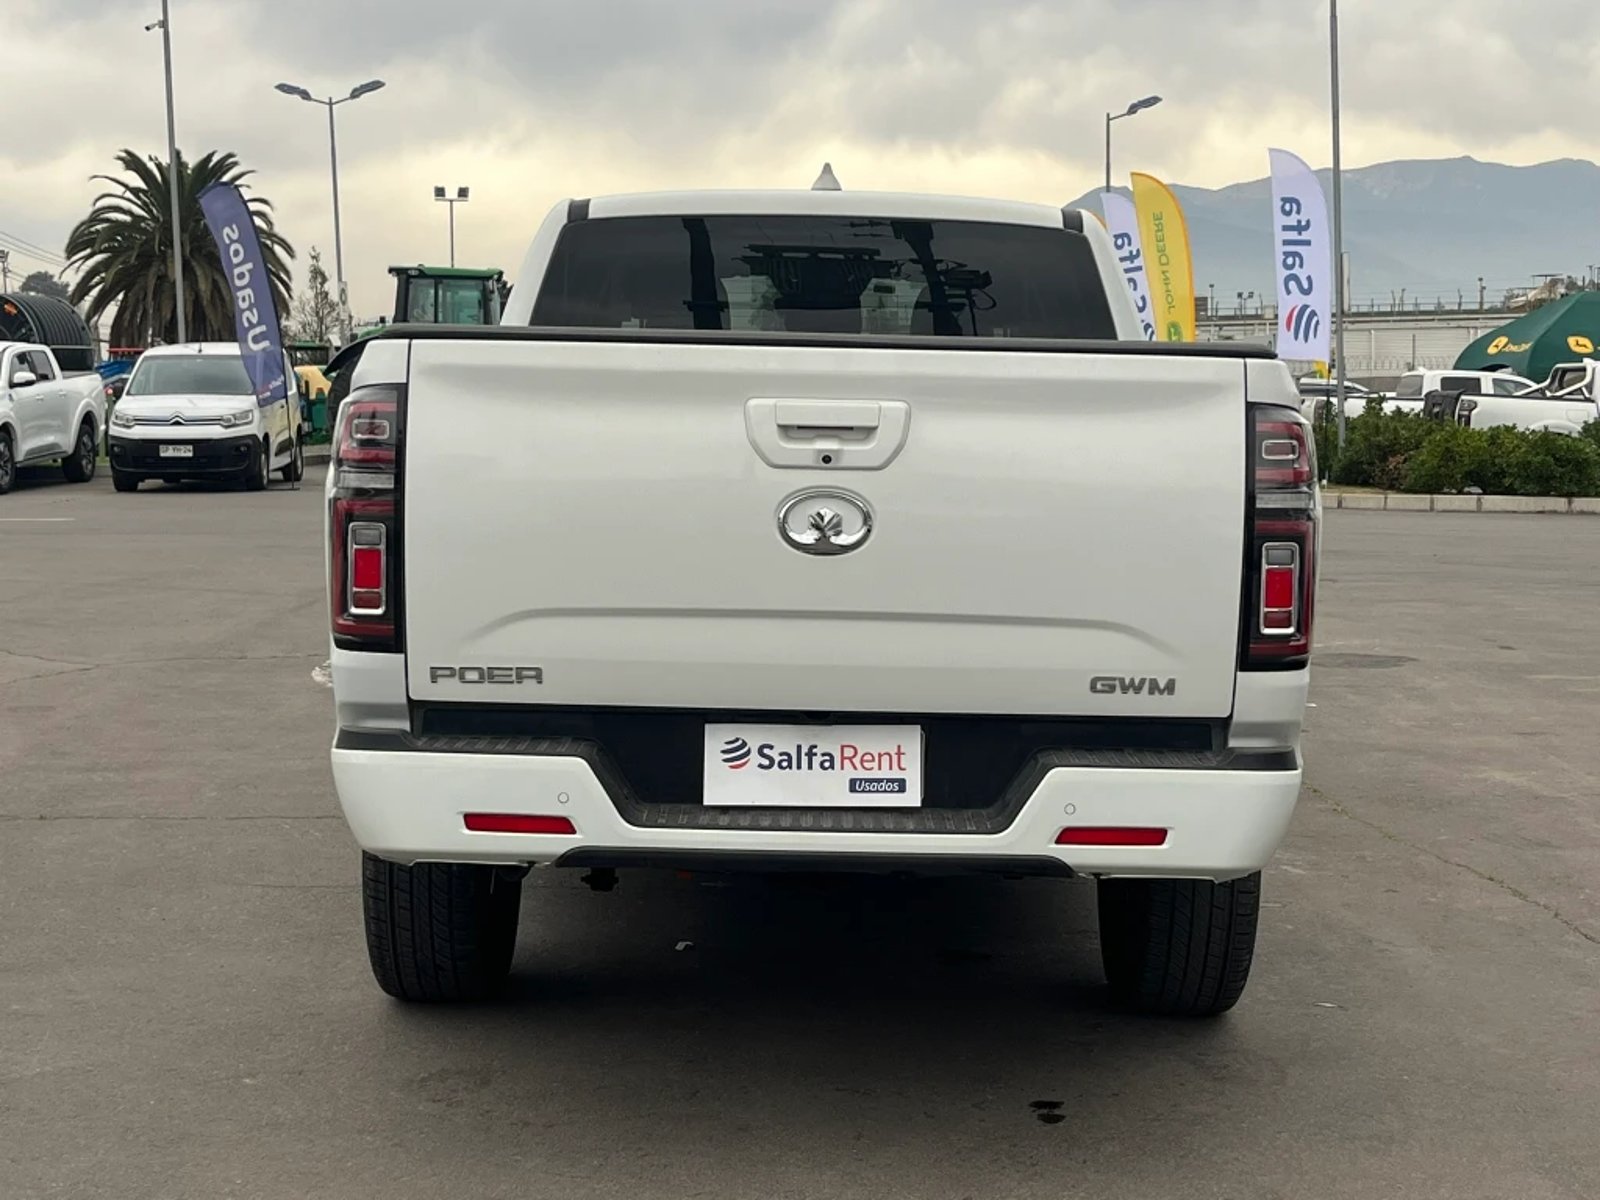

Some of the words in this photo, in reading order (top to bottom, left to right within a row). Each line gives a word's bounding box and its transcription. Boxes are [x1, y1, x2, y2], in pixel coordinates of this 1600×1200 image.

[429, 666, 543, 684] POER
[1089, 676, 1176, 696] GWM
[757, 743, 906, 770] SalfaRent
[855, 779, 899, 791] Usados
